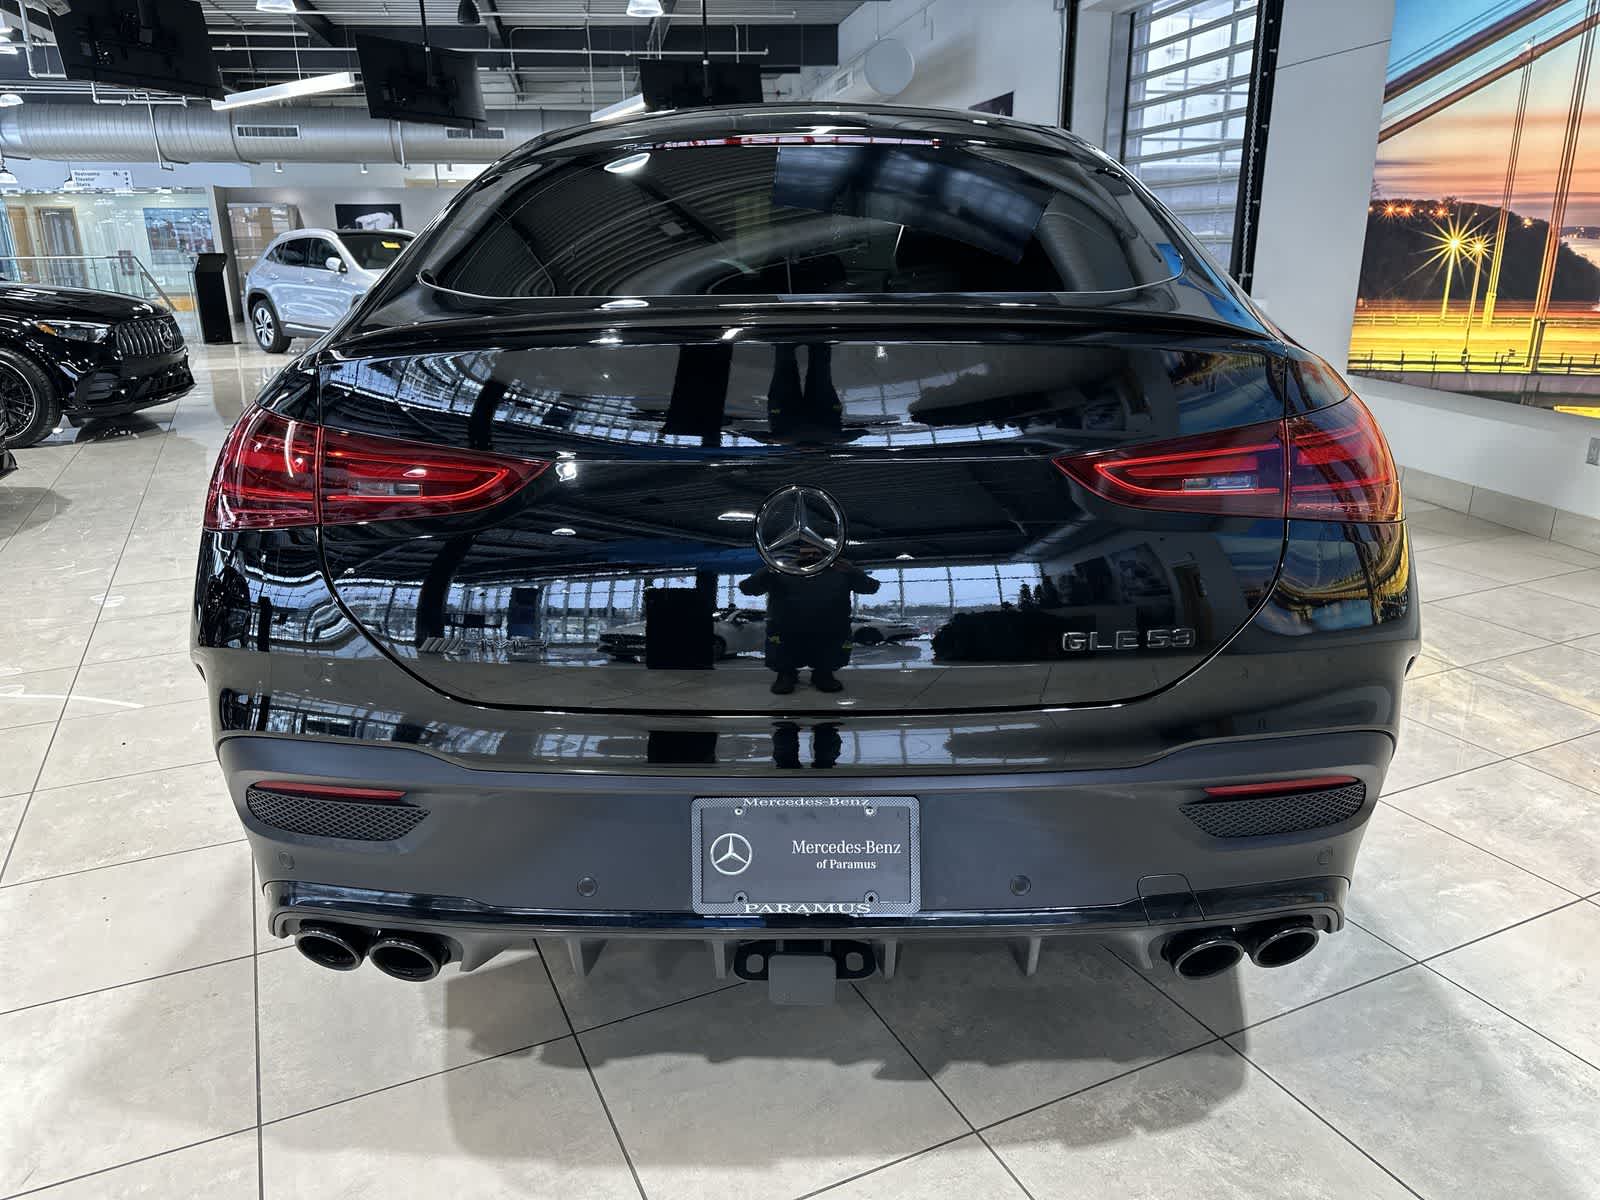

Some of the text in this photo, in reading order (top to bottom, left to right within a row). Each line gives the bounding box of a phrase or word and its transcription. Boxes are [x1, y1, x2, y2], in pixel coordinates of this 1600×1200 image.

[1062, 628, 1196, 651] GLE 53
[742, 798, 871, 807] Mercedes-Benz
[791, 839, 902, 855] Mercedes-Benz
[816, 859, 877, 870] of Paramus
[744, 903, 872, 914] PARAMUS
